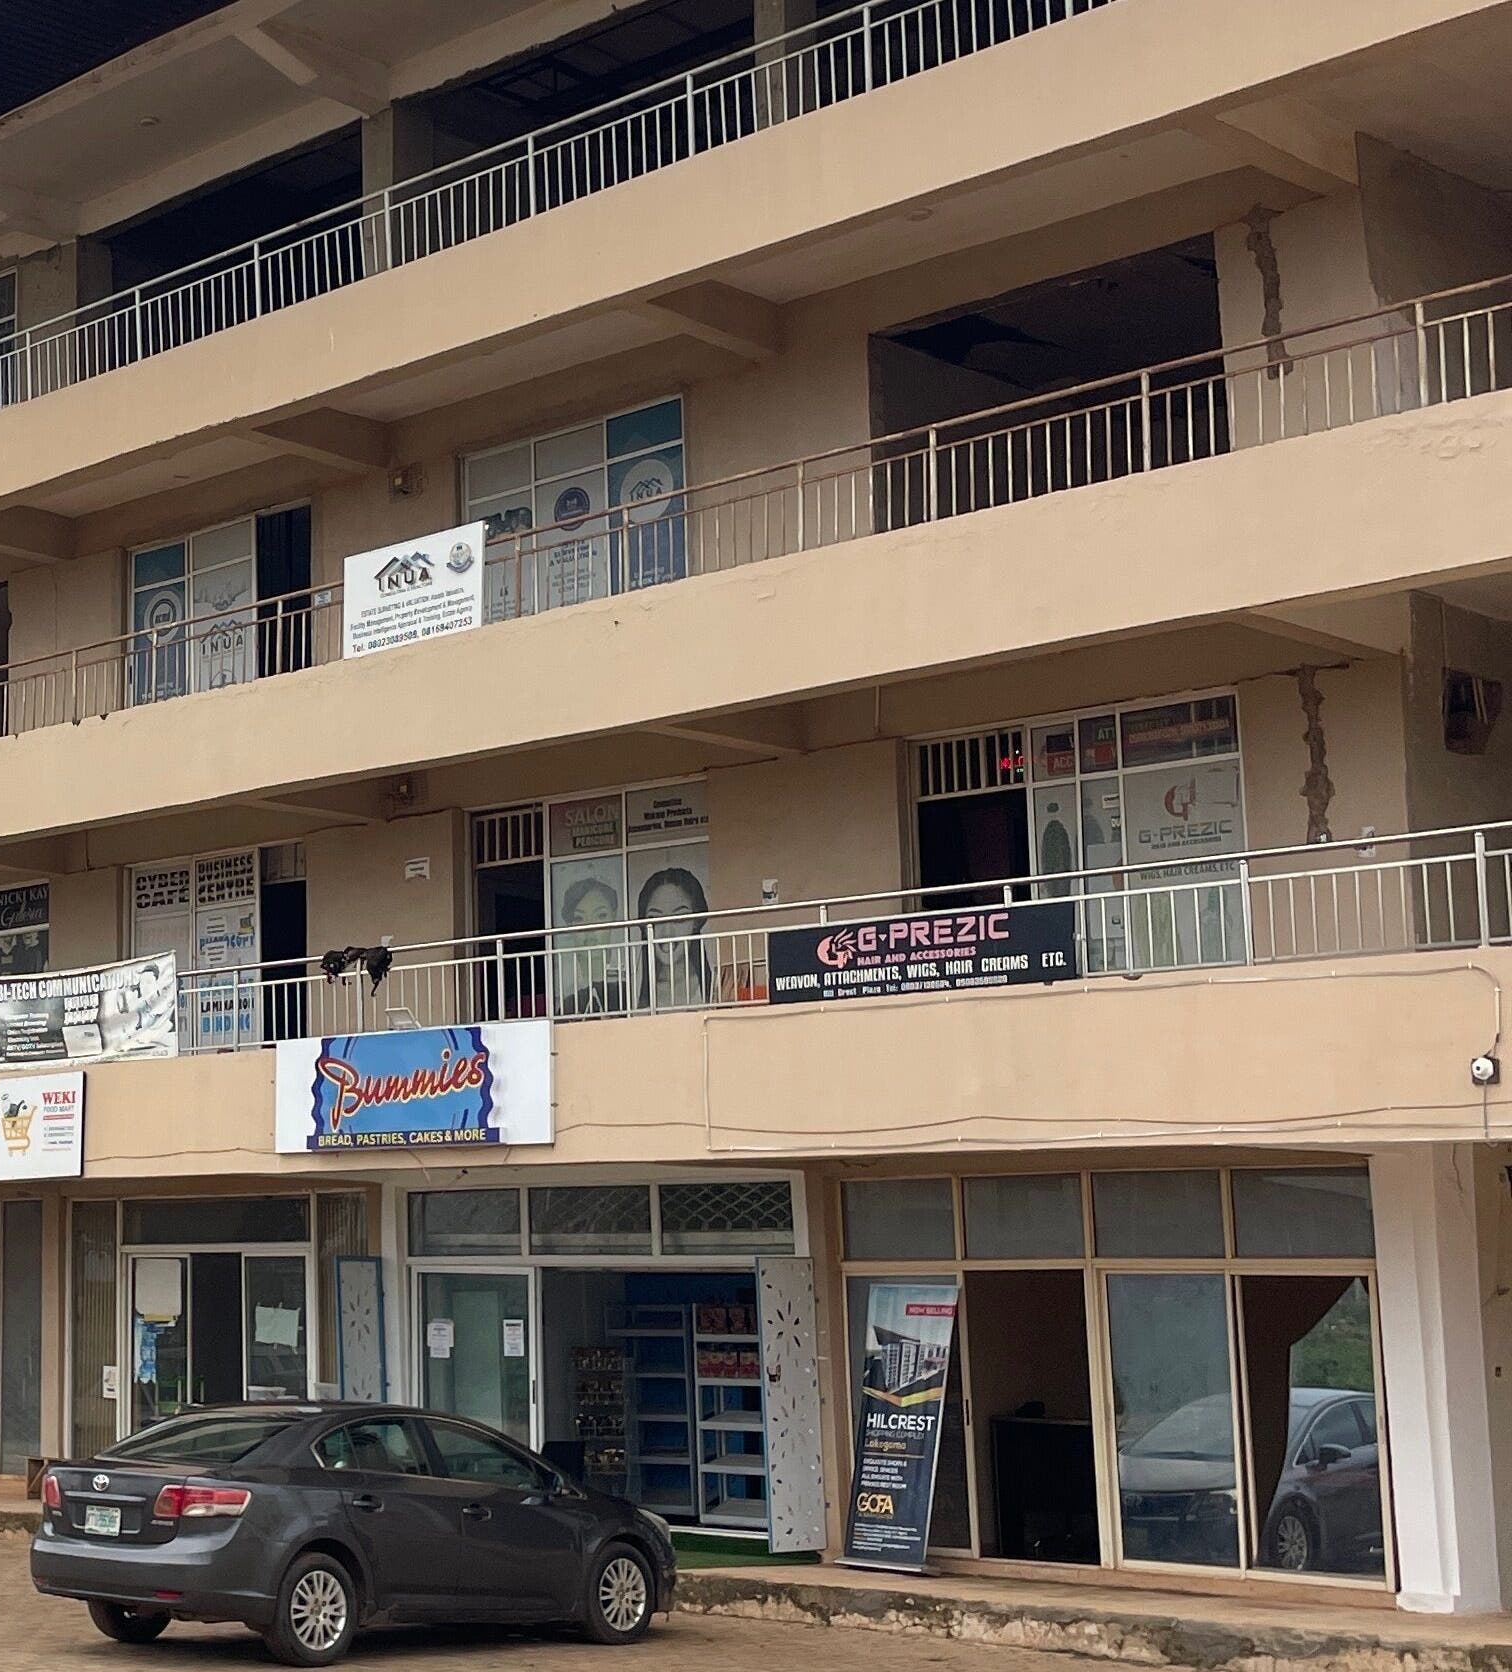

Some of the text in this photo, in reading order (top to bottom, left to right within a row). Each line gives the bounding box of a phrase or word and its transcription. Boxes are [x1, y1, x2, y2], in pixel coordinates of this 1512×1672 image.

[378, 567, 430, 592] INUA
[202, 632, 244, 656] INUA
[1138, 818, 1234, 845] G-PREZIC
[856, 912, 1010, 951] G-PREZIC
[857, 947, 977, 967] HAIR AND ACCESSORIES
[775, 951, 1067, 991] WEAVON, ATTACHMENTS, WIGS, HAIR CREAMS ETC.
[42, 1090, 76, 1104] WEKI
[318, 1049, 486, 1133] Bummies
[318, 1128, 486, 1148] BREAD, PASTRIES, CAKES & MORE
[866, 1412, 936, 1432] HILCREST
